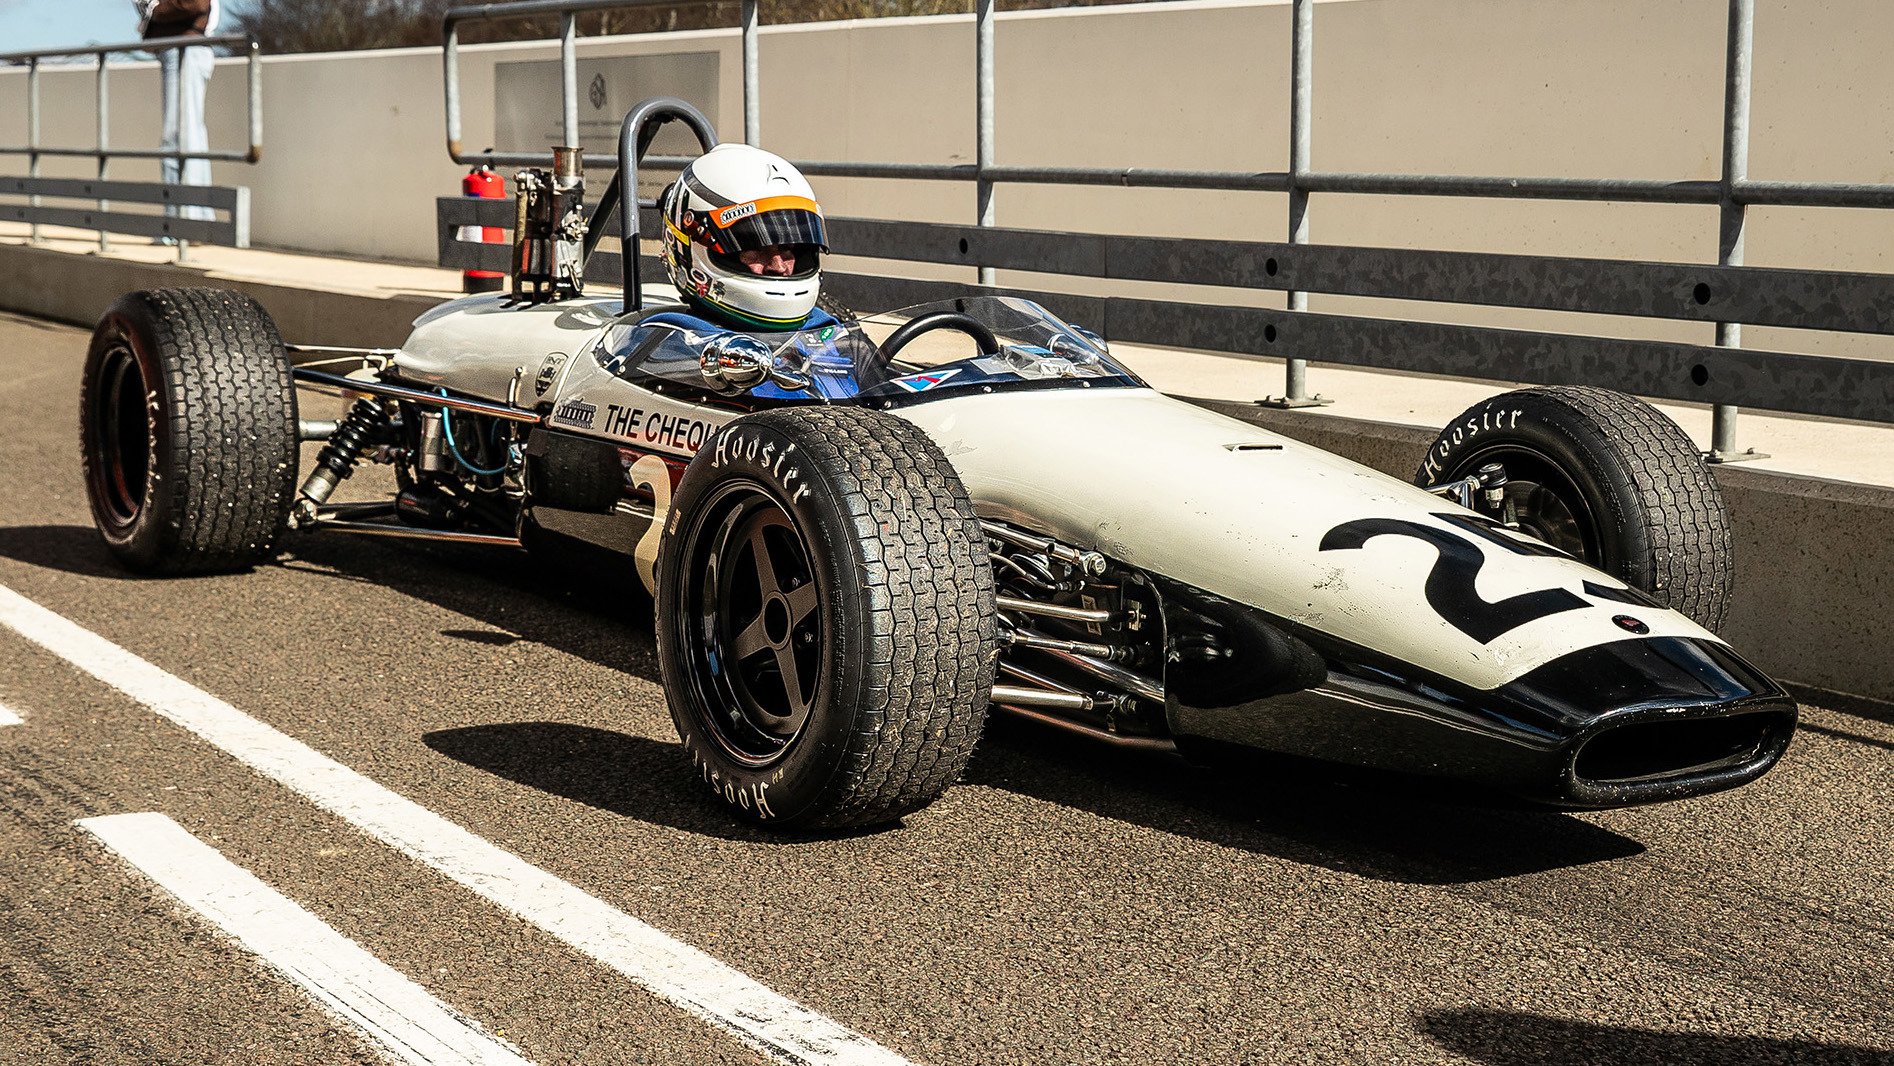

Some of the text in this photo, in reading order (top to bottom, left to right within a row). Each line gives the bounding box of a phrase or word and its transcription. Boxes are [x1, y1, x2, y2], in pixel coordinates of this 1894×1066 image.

[604, 404, 644, 438] THE
[1423, 402, 1524, 486] Hoosier
[711, 425, 812, 505] Hoosier
